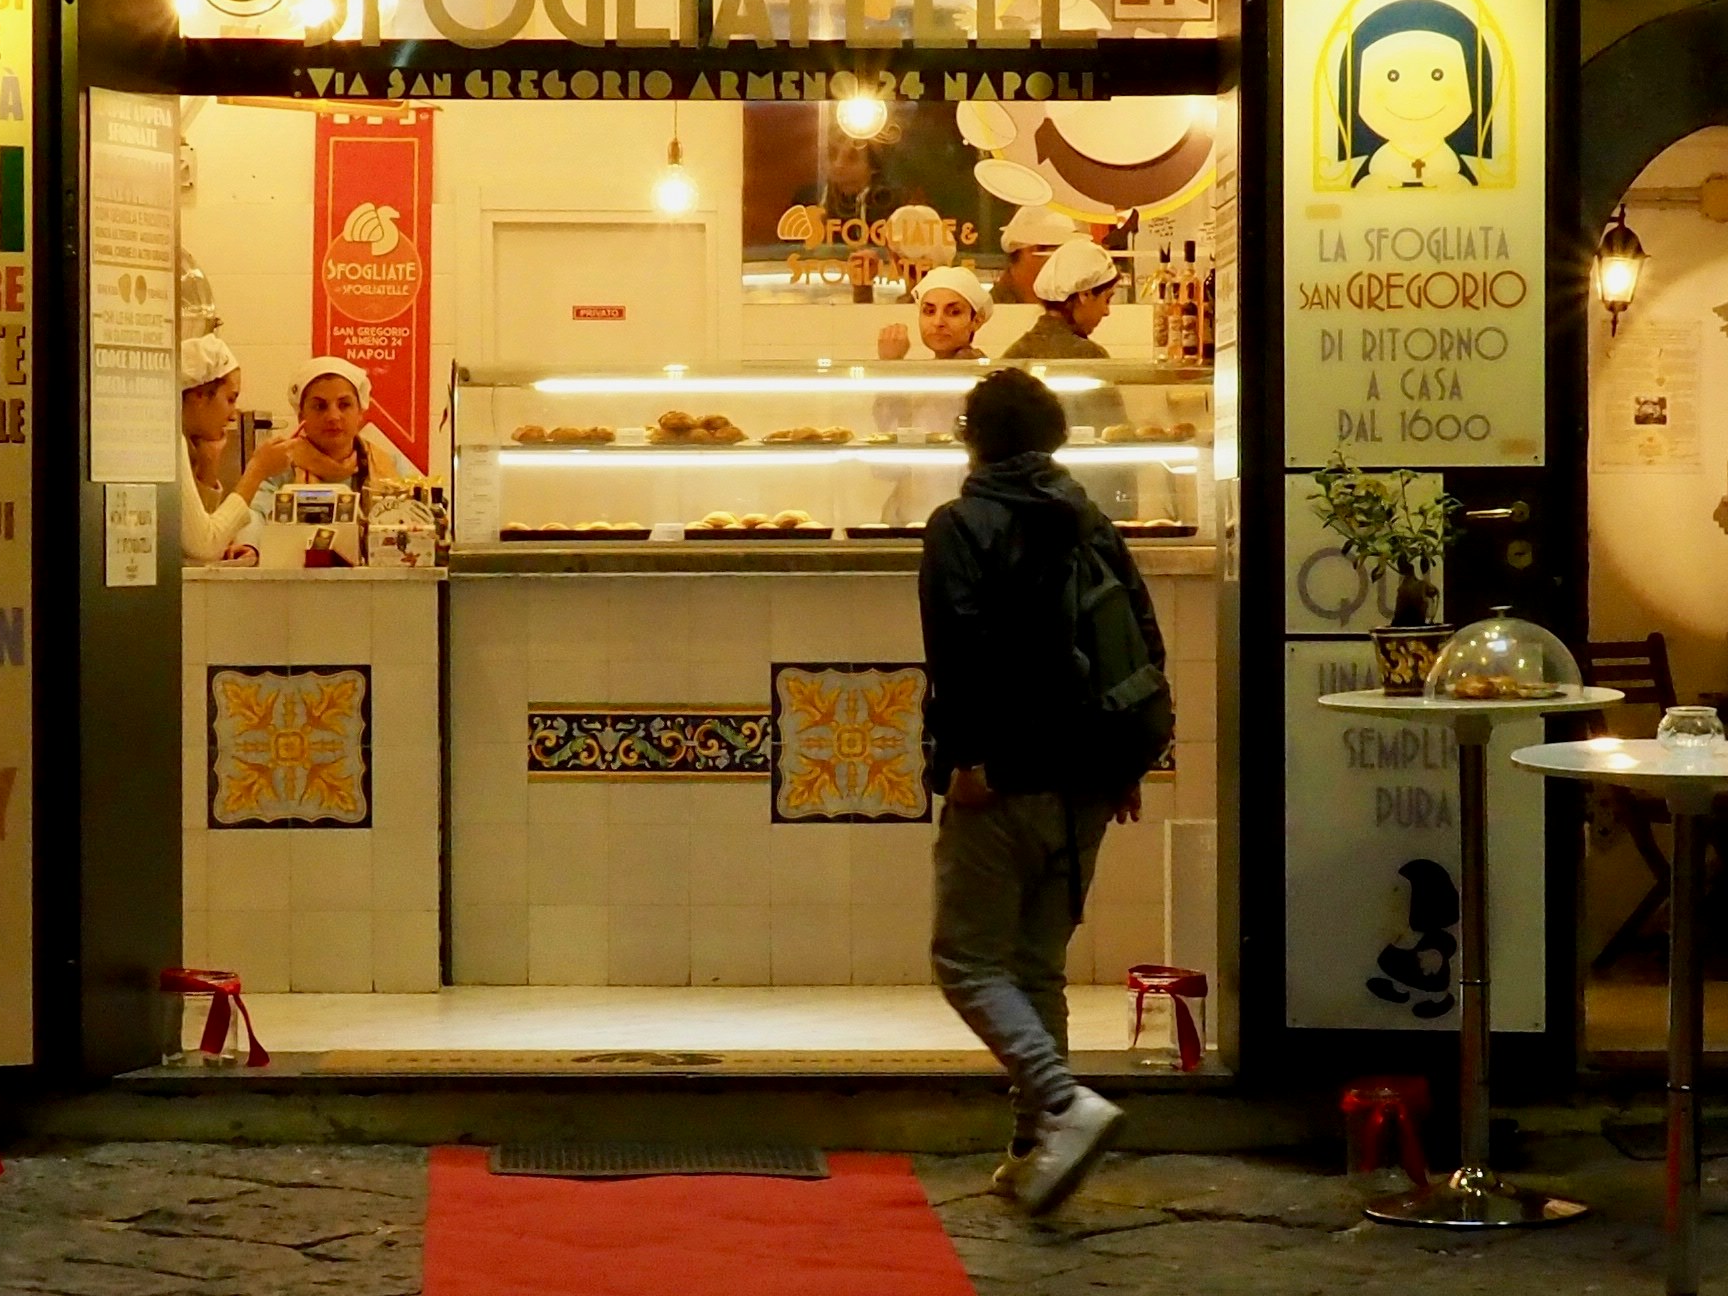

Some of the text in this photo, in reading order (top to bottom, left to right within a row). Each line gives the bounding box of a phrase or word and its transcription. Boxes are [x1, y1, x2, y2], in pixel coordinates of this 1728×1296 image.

[387, 67, 452, 99] SAN
[464, 69, 673, 100] GREGORIO
[687, 70, 860, 100] ARMENO
[879, 70, 925, 100] 24
[944, 70, 1094, 100] NAPOLI
[1318, 225, 1511, 266] LA SFOGLIATA
[326, 258, 417, 281] SFOGLIATE
[1299, 270, 1527, 313] SAN GREGORIO
[332, 326, 410, 337] SAN GREGORIO
[391, 337, 403, 347] 24
[1320, 325, 1509, 363] DI RITORNO
[346, 349, 396, 361] NAPOLI
[1366, 368, 1463, 402] A CASA
[1338, 408, 1492, 443] DAL 1600
[1375, 785, 1453, 828] PURA
